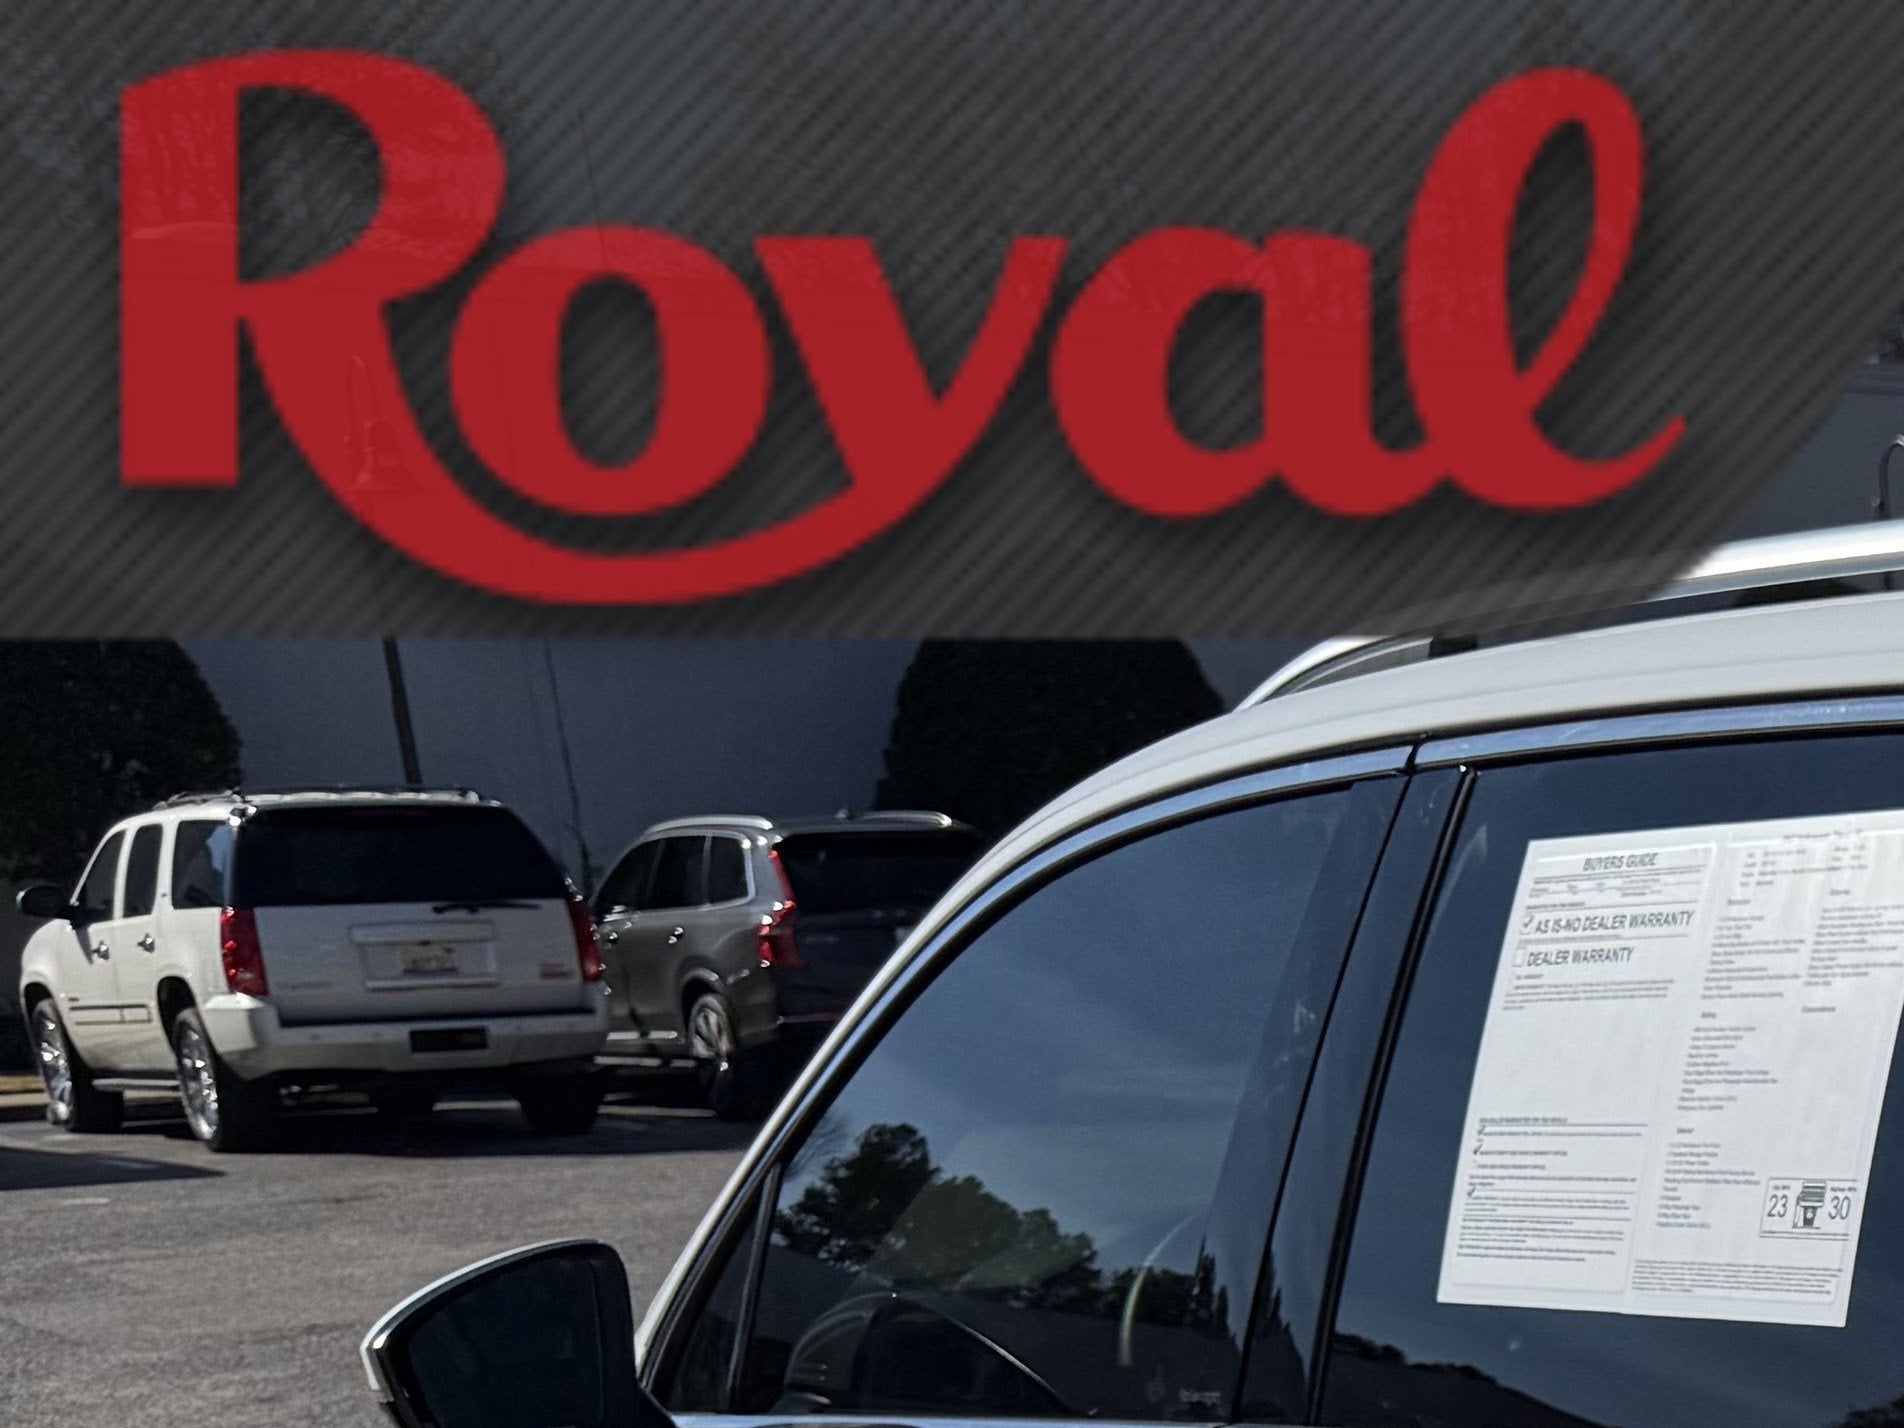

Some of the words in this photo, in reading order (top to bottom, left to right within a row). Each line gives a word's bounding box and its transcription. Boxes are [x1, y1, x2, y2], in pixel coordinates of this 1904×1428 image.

[1583, 855, 1624, 872] BUYERS
[1626, 853, 1658, 868] GUIDE
[1535, 919, 1549, 934] AS
[1582, 914, 1627, 932] DEALER
[1629, 910, 1695, 927] WARRANTY
[1527, 950, 1569, 967] DEALER
[1572, 947, 1634, 965] WARRANTY
[1767, 1194, 1788, 1218] 23
[1828, 1195, 1851, 1220] 30
